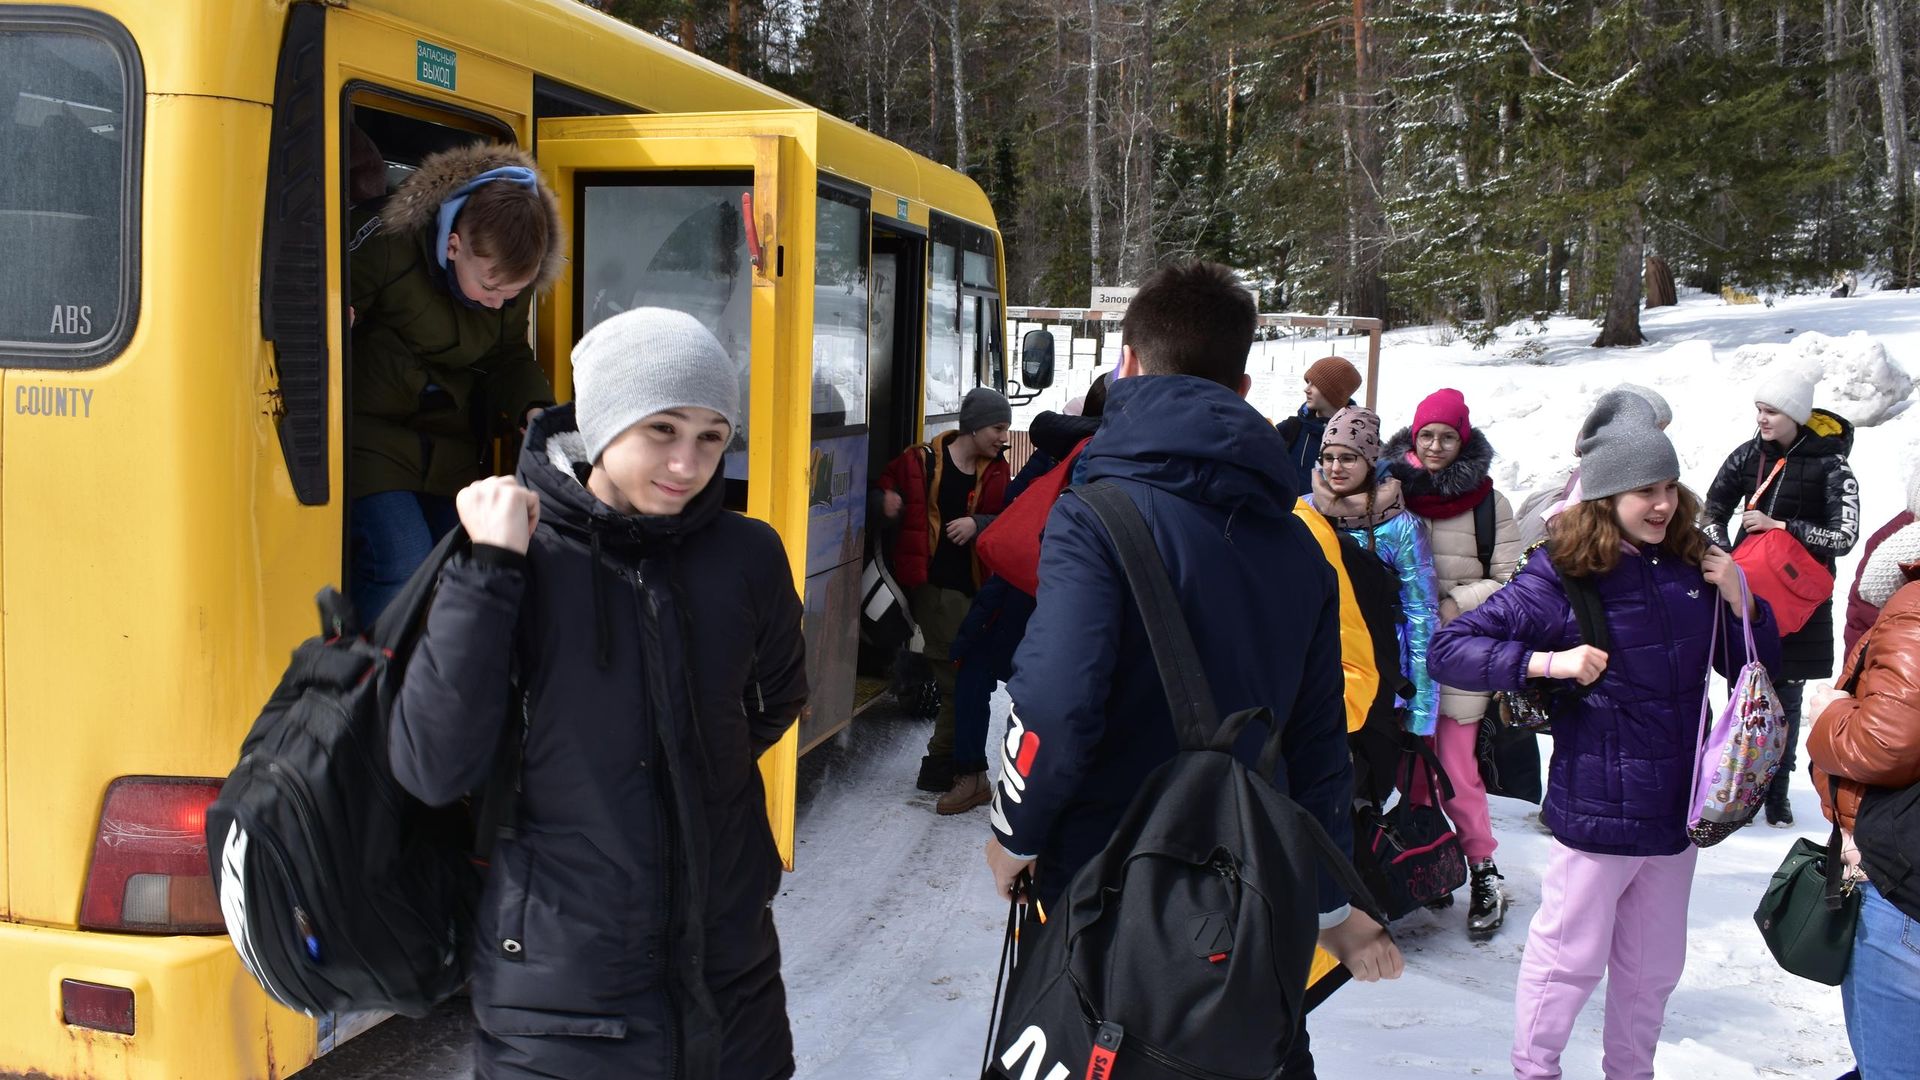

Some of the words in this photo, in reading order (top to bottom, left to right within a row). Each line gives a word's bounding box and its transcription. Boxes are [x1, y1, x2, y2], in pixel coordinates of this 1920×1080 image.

[417, 45, 456, 66] ЗАПАСНЫЙ
[423, 61, 450, 88] ВЫХОД
[50, 304, 92, 335] ABS
[15, 385, 94, 418] COUNTY
[1806, 534, 1829, 547] INTO
